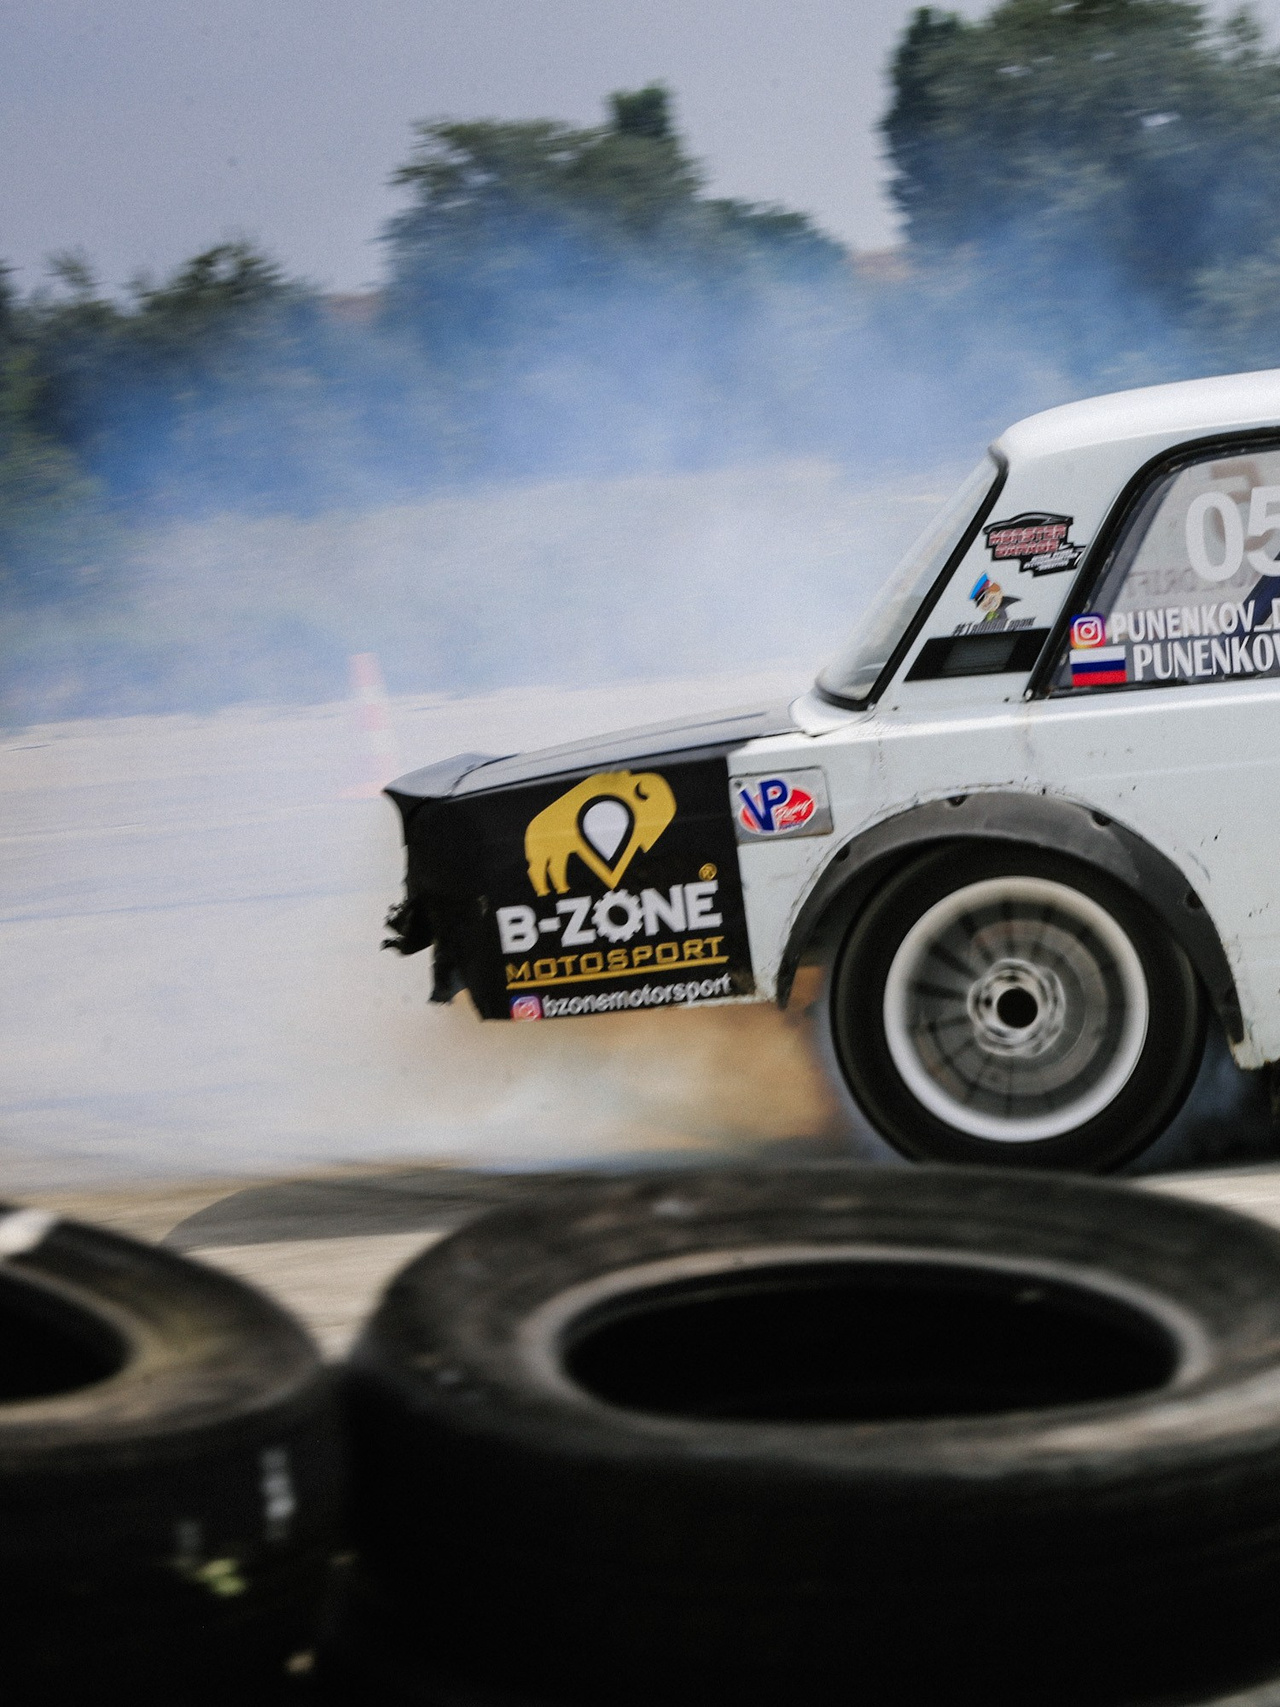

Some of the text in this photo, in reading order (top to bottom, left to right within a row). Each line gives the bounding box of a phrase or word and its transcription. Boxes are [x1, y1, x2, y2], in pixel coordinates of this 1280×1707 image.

[740, 779, 788, 832] VP
[496, 879, 724, 955] B-ZONE
[505, 935, 726, 983] MOTOSPORT
[542, 972, 732, 1018] bzonemotorsport
